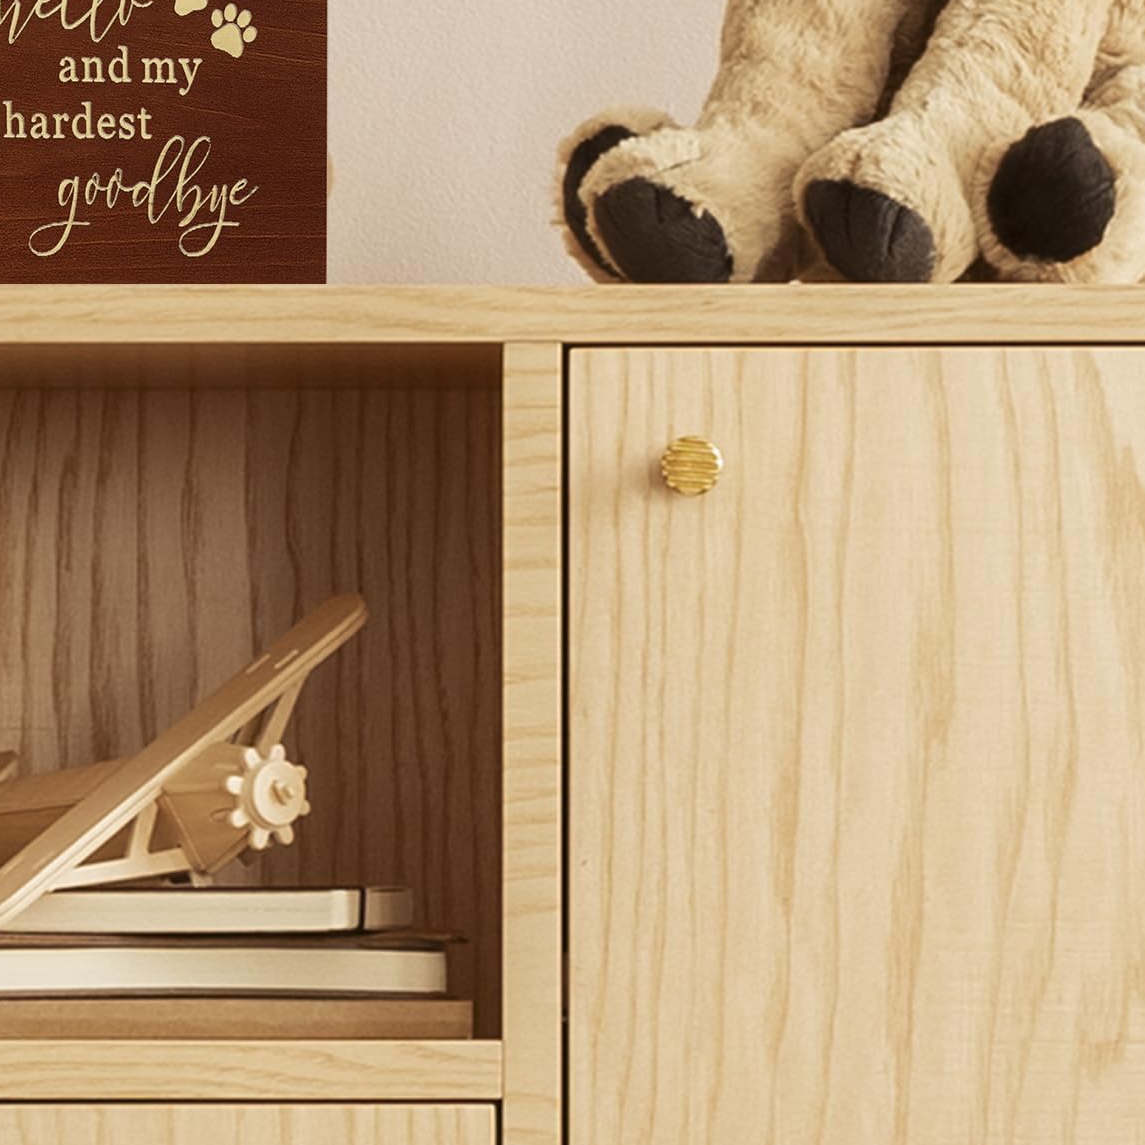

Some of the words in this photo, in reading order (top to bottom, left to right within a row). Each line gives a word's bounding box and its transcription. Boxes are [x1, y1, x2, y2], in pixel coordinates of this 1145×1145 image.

[59, 46, 132, 84] and
[141, 57, 203, 96] my
[3, 100, 153, 140] hardest
[28, 135, 259, 257] goodbye
